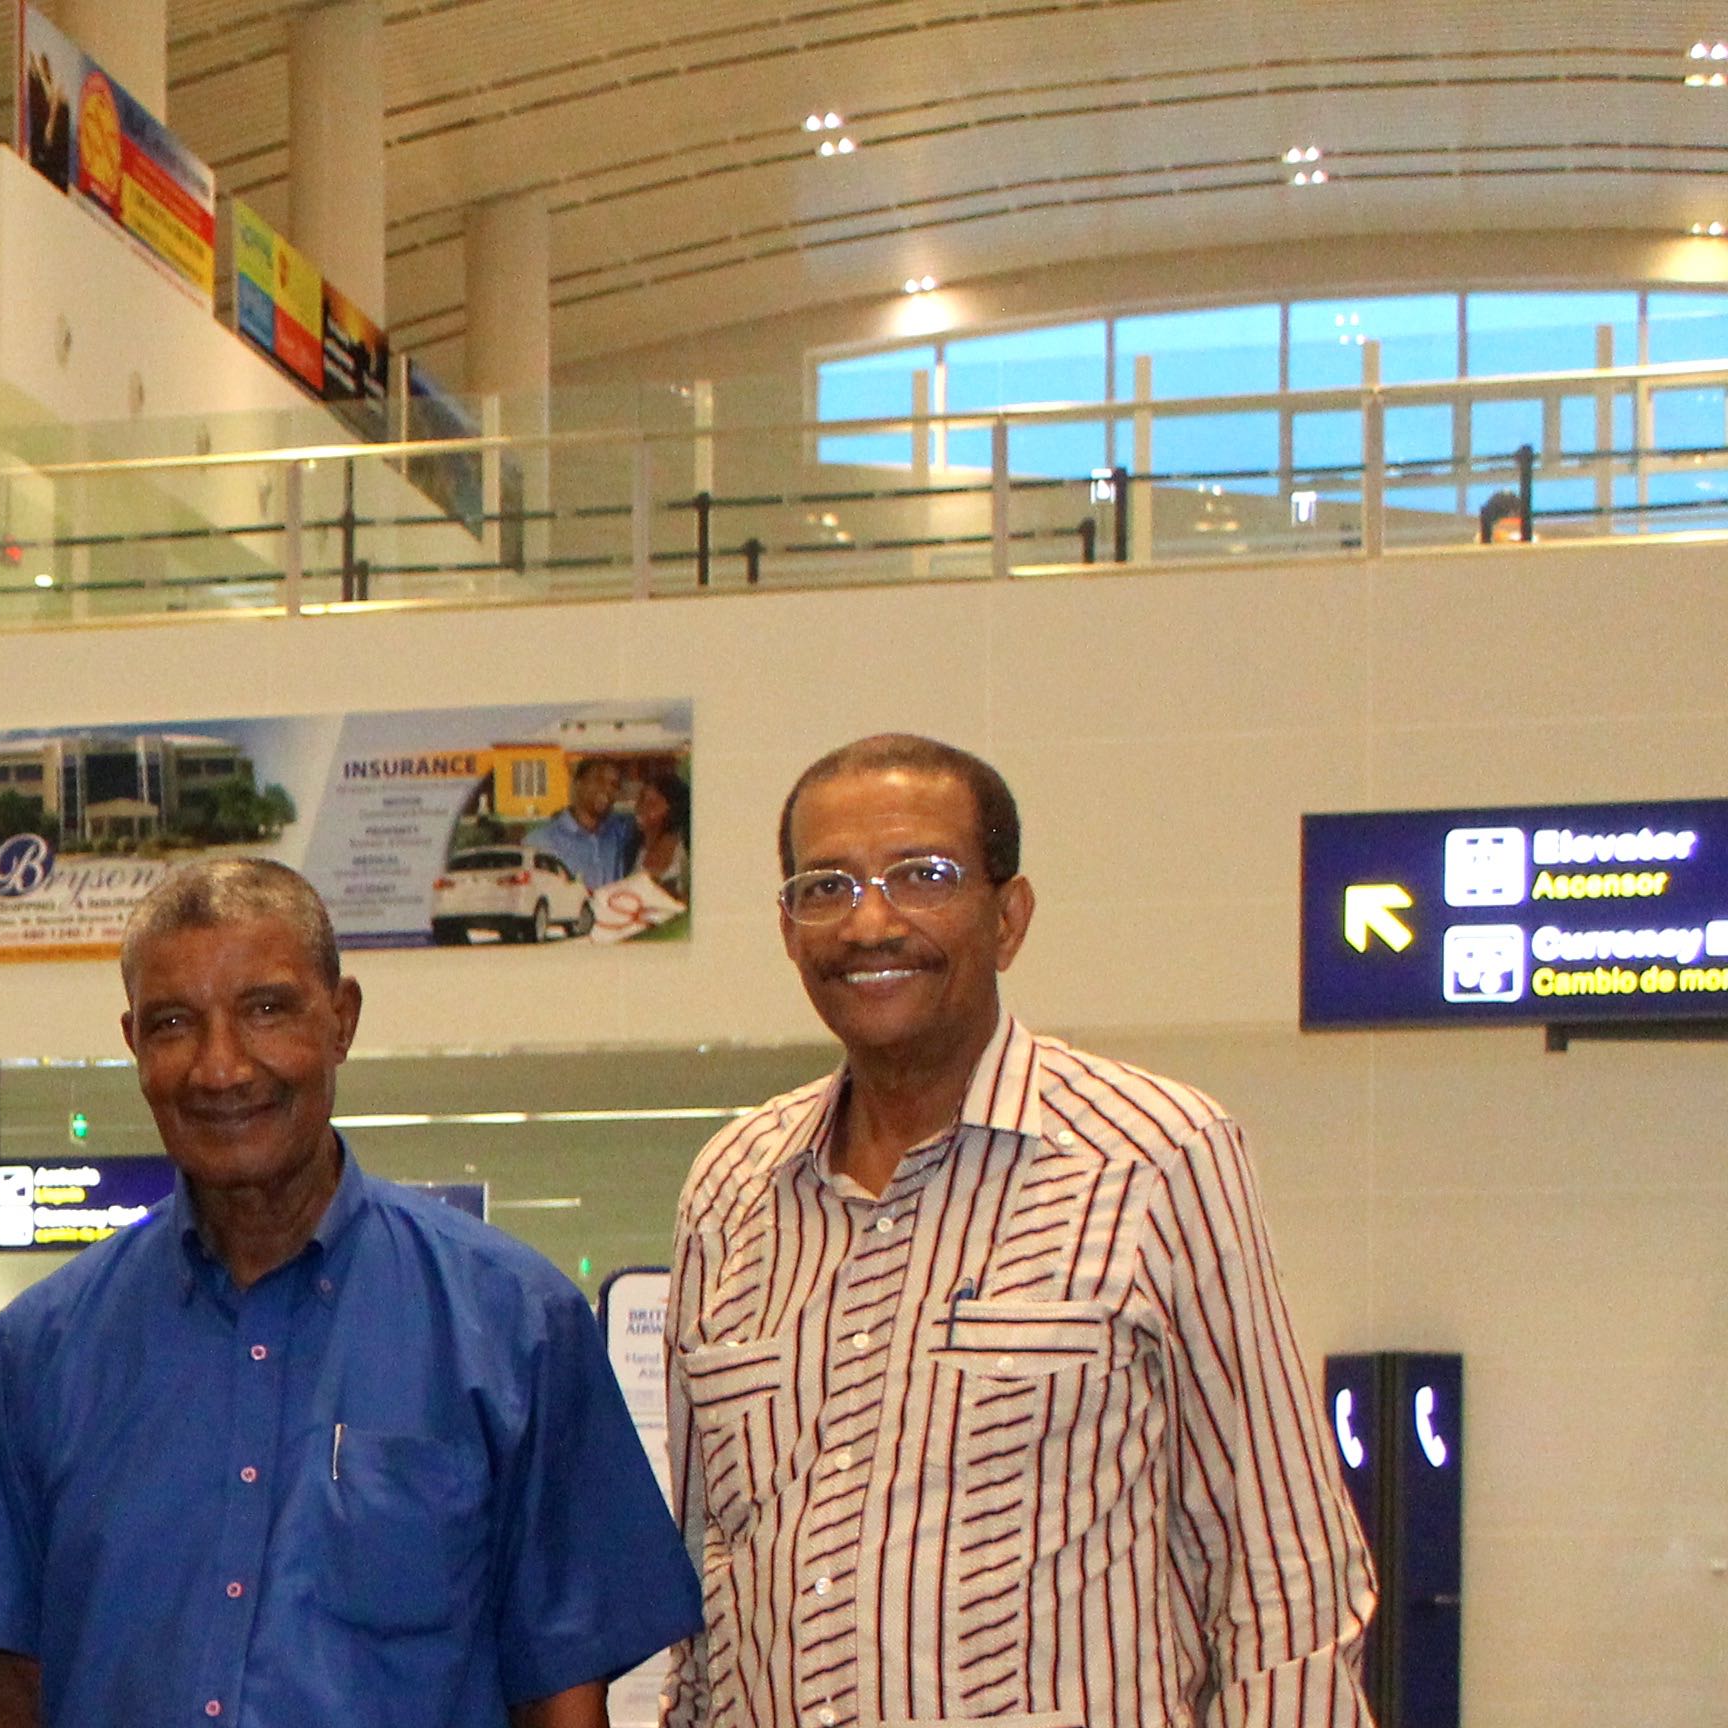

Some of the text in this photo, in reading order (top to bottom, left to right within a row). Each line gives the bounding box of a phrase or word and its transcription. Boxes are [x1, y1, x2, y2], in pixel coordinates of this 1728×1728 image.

[344, 754, 477, 780] INSURANCE
[1533, 827, 1697, 864] Elevator
[1531, 871, 1669, 900] Ascensor
[1531, 925, 1704, 965] Currency
[1531, 966, 1639, 996] Cambio
[1639, 965, 1678, 994] de
